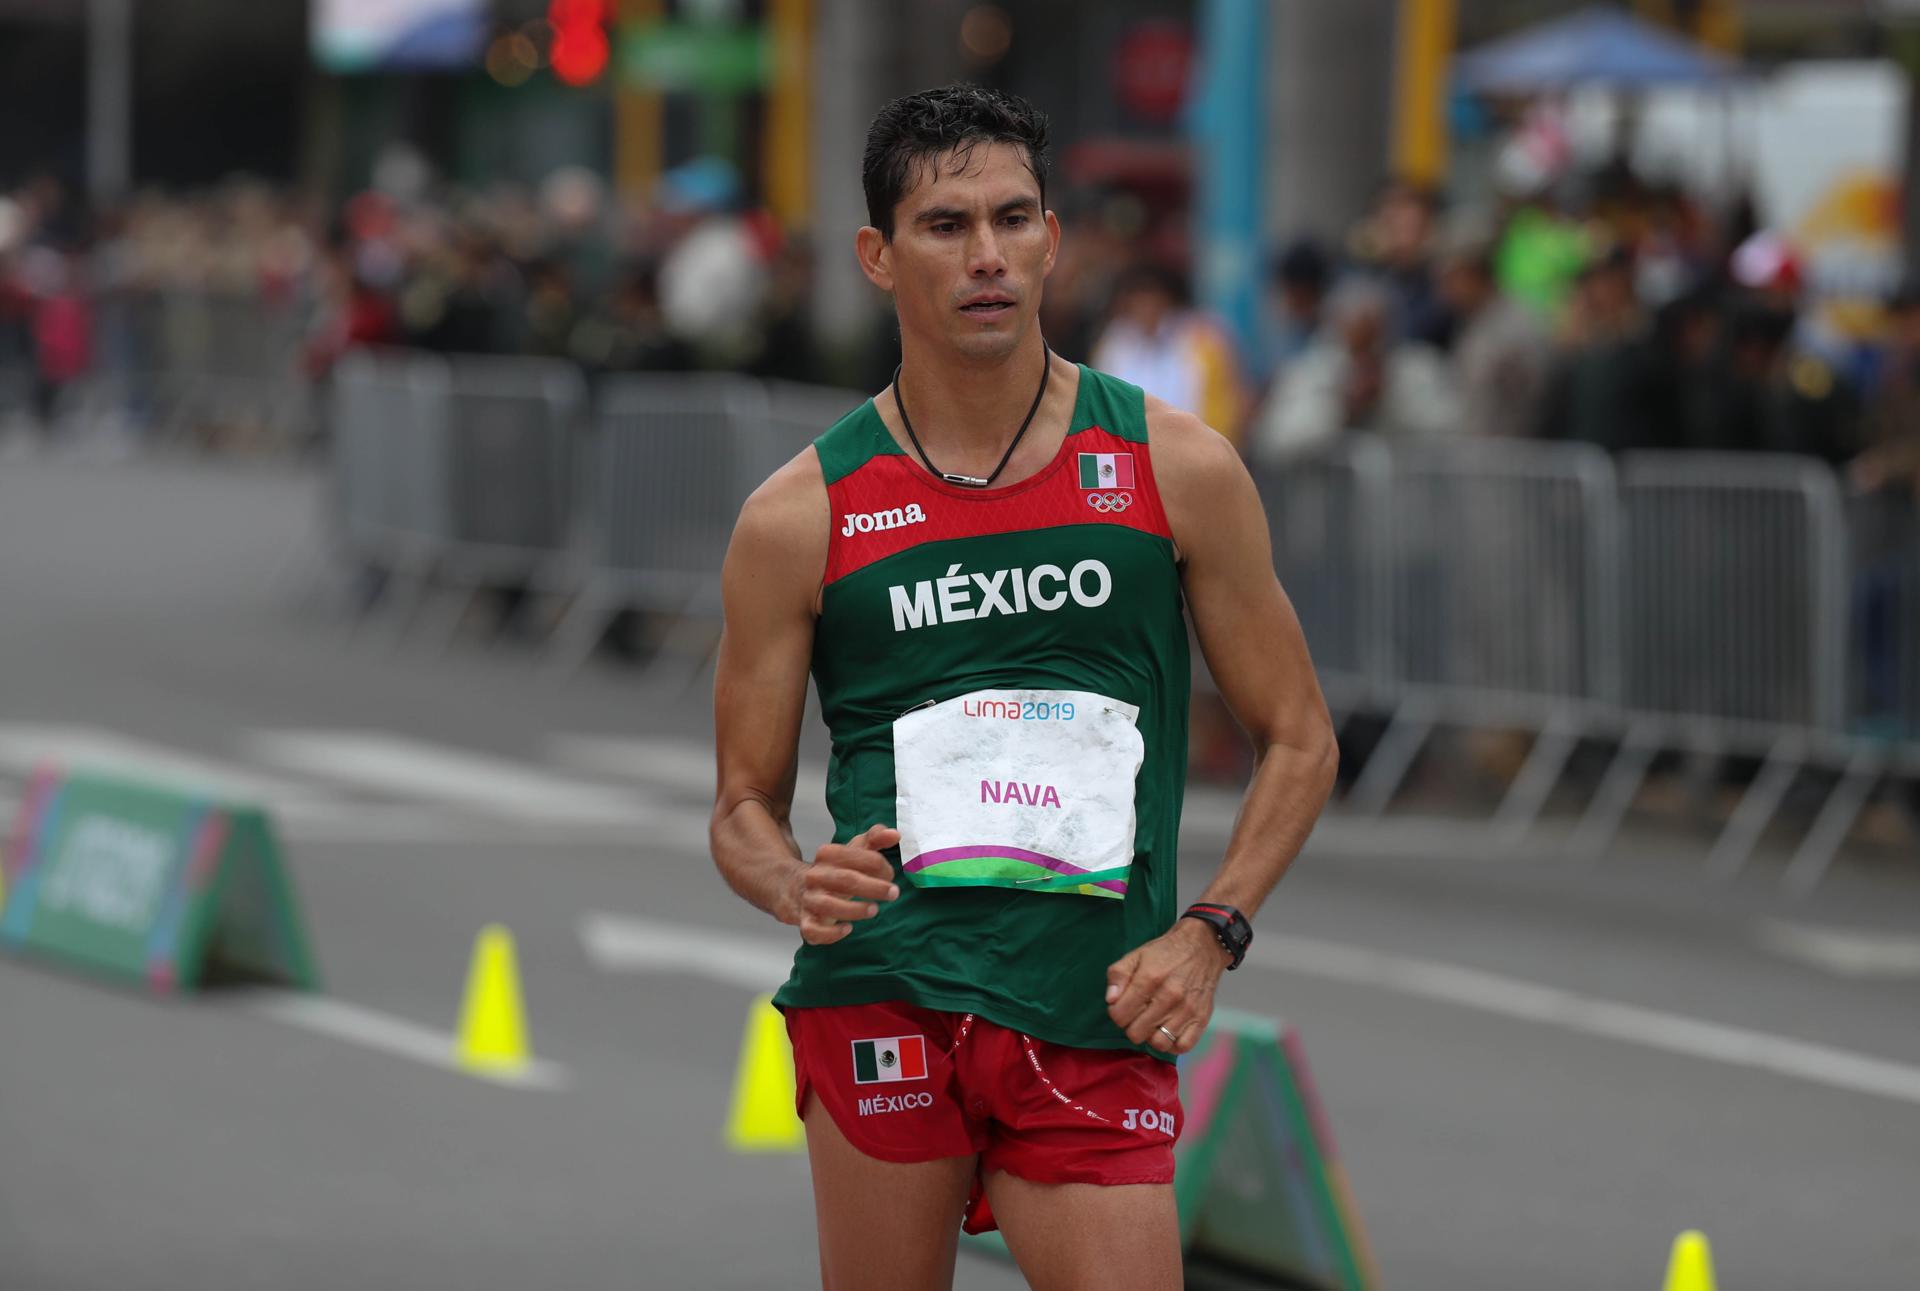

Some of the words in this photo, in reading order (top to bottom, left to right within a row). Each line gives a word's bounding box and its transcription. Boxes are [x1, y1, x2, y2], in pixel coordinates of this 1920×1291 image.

[841, 503, 927, 538] Joma
[888, 558, 1112, 632] MÉXICO
[980, 779, 1062, 809] NAVA
[858, 1091, 933, 1116] MÉXICO
[1122, 1108, 1175, 1138] Jom
